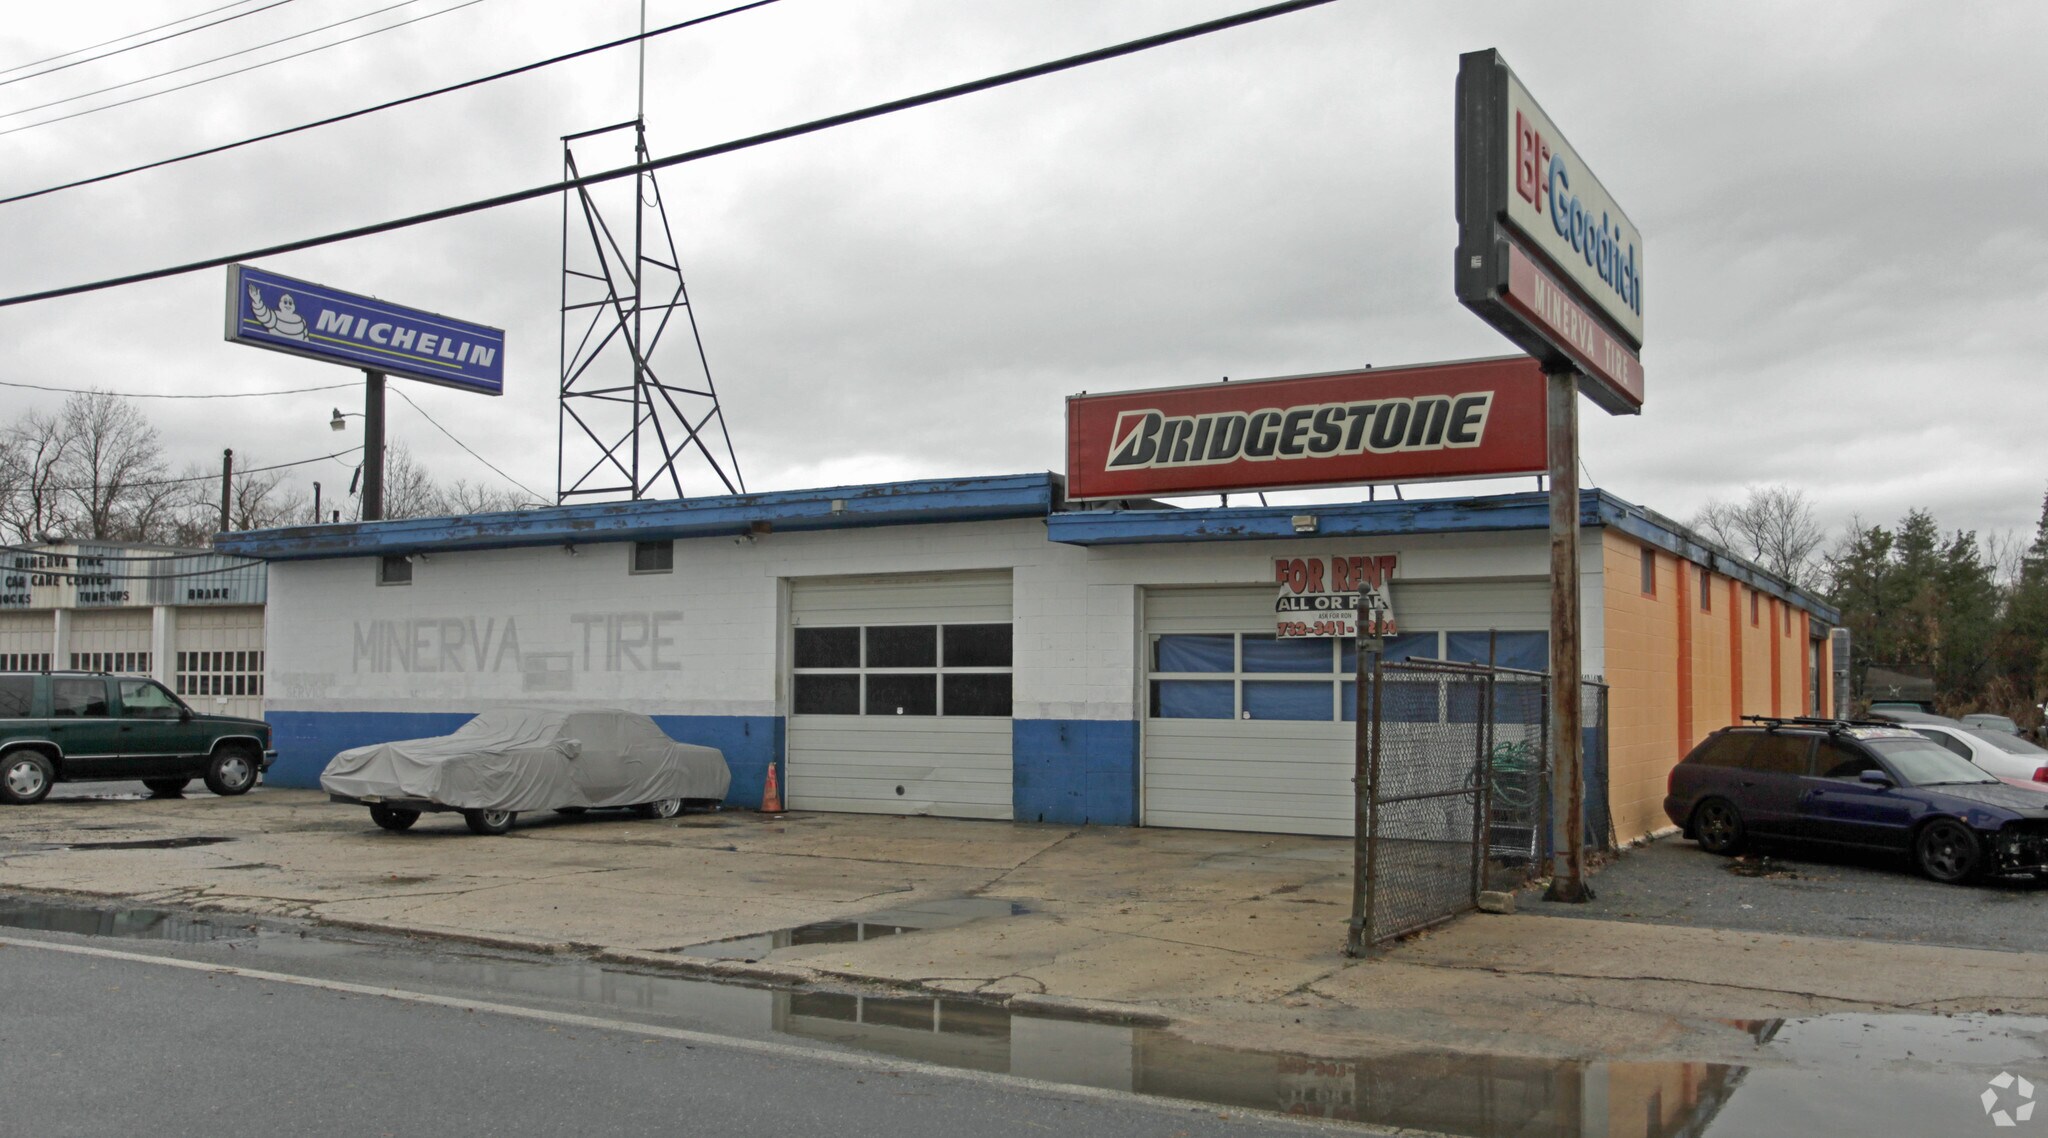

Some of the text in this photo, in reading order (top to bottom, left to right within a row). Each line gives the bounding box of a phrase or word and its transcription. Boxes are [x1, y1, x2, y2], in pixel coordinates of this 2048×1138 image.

[1515, 106, 1640, 318] BFGoodrich
[315, 308, 496, 368] MICHELIN
[1534, 273, 1629, 386] MINERVA TIRE
[1106, 391, 1494, 471] BRIDGESTONE
[5, 575, 27, 588] CAR
[31, 574, 60, 587] CARE
[15, 554, 69, 568] MINERVA
[1275, 555, 1397, 594] FOR RENT
[188, 588, 229, 600] BRAKE
[1278, 597, 1309, 611] ALL
[1314, 596, 1343, 609] OR
[352, 610, 684, 674] MINERVA TIRE
